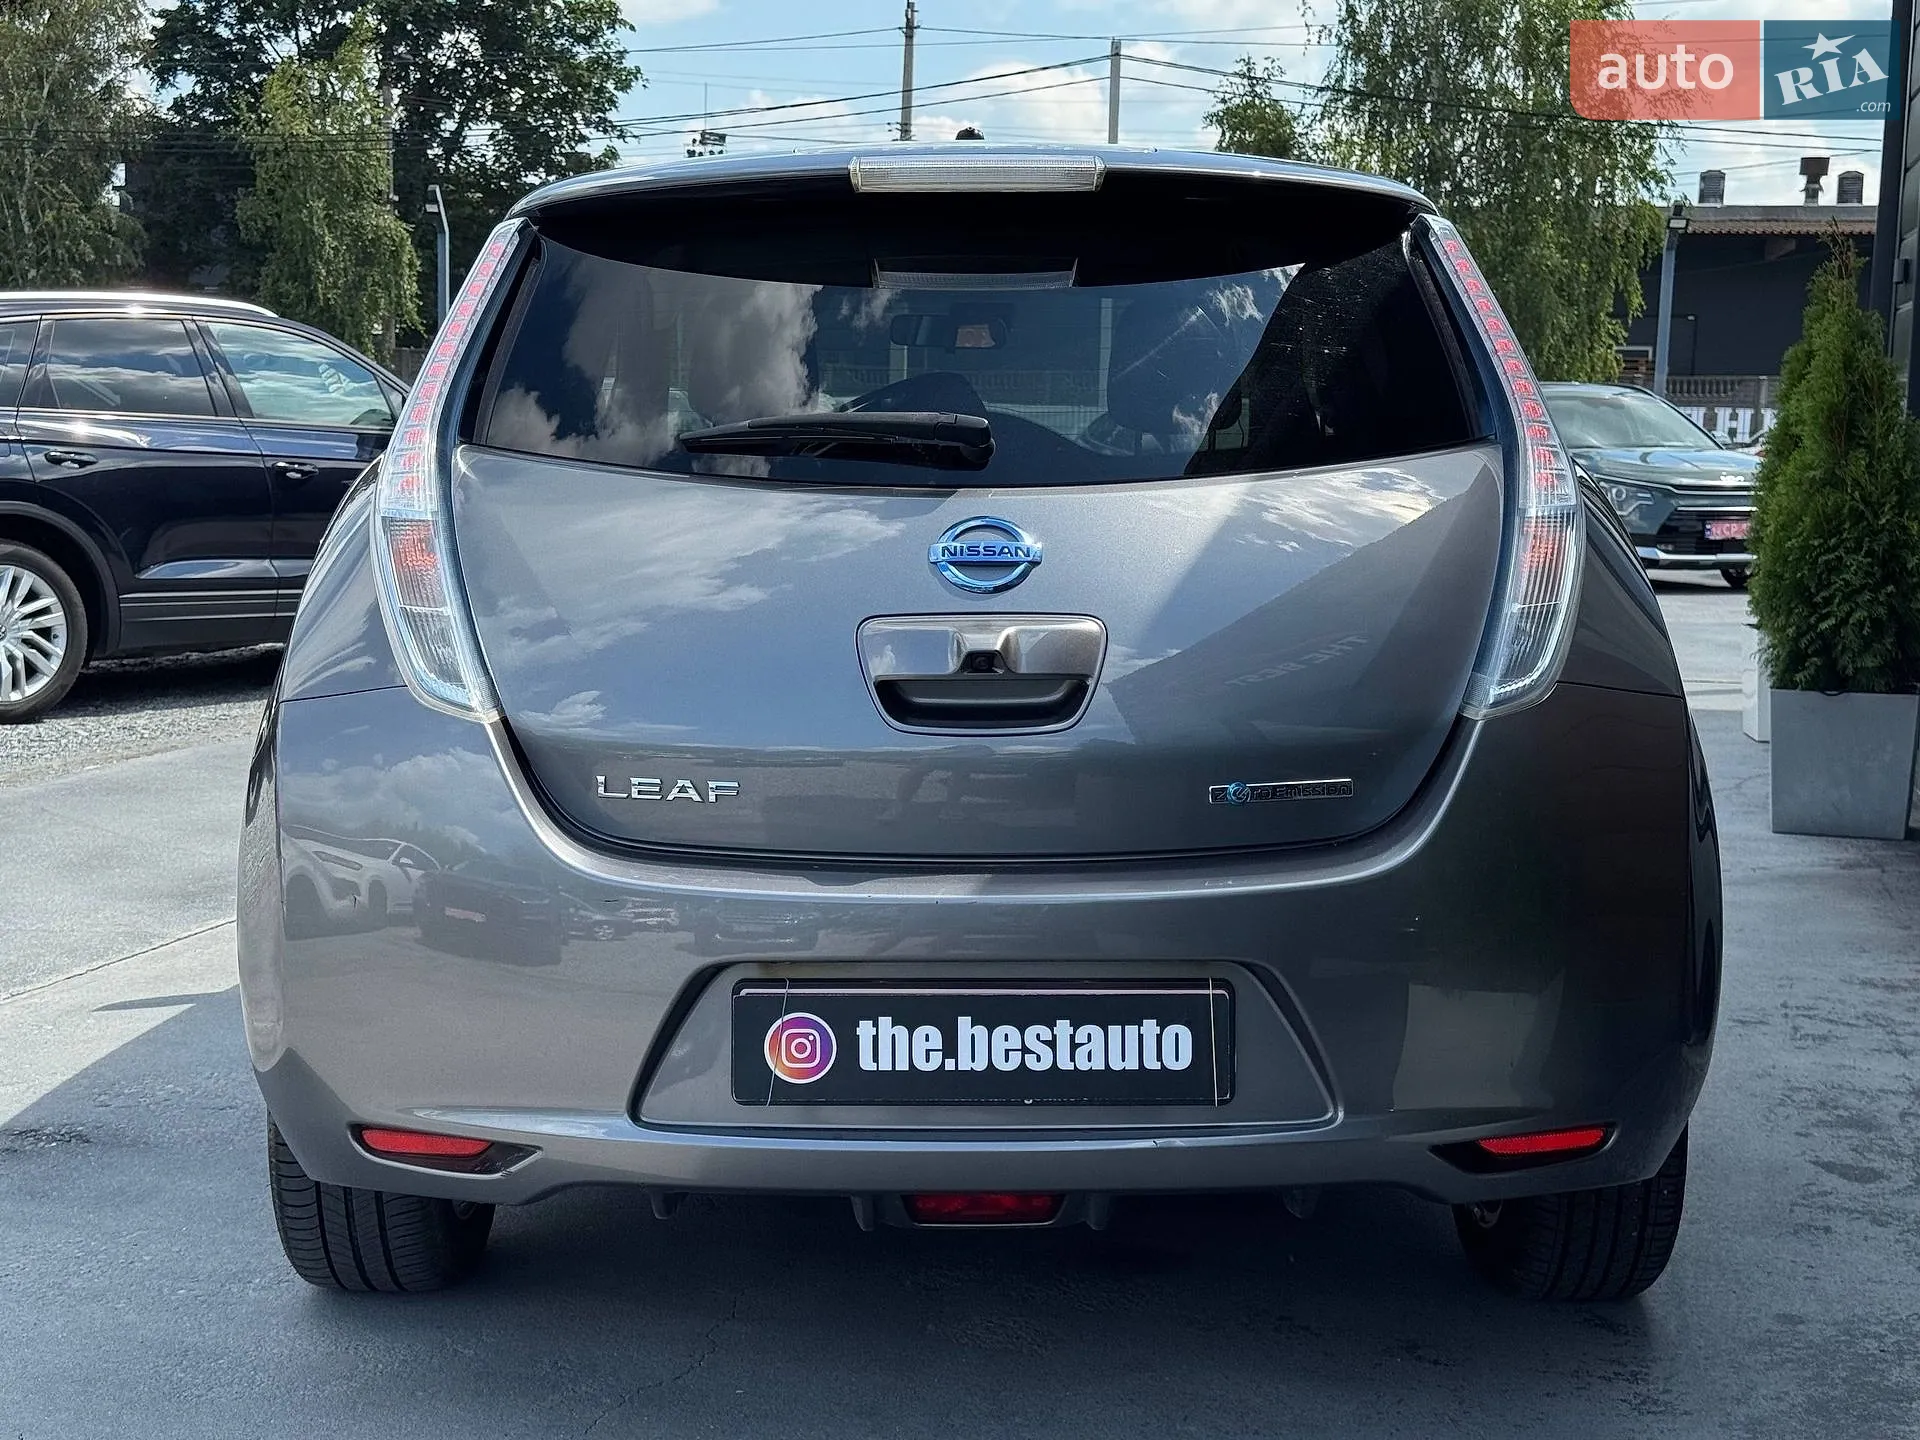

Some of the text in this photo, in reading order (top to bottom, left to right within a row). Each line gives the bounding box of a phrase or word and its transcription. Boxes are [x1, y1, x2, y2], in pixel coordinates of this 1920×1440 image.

[941, 545, 1031, 558] NISSAN
[596, 775, 740, 803] LEAF
[856, 1016, 1193, 1072] the.bestauto
